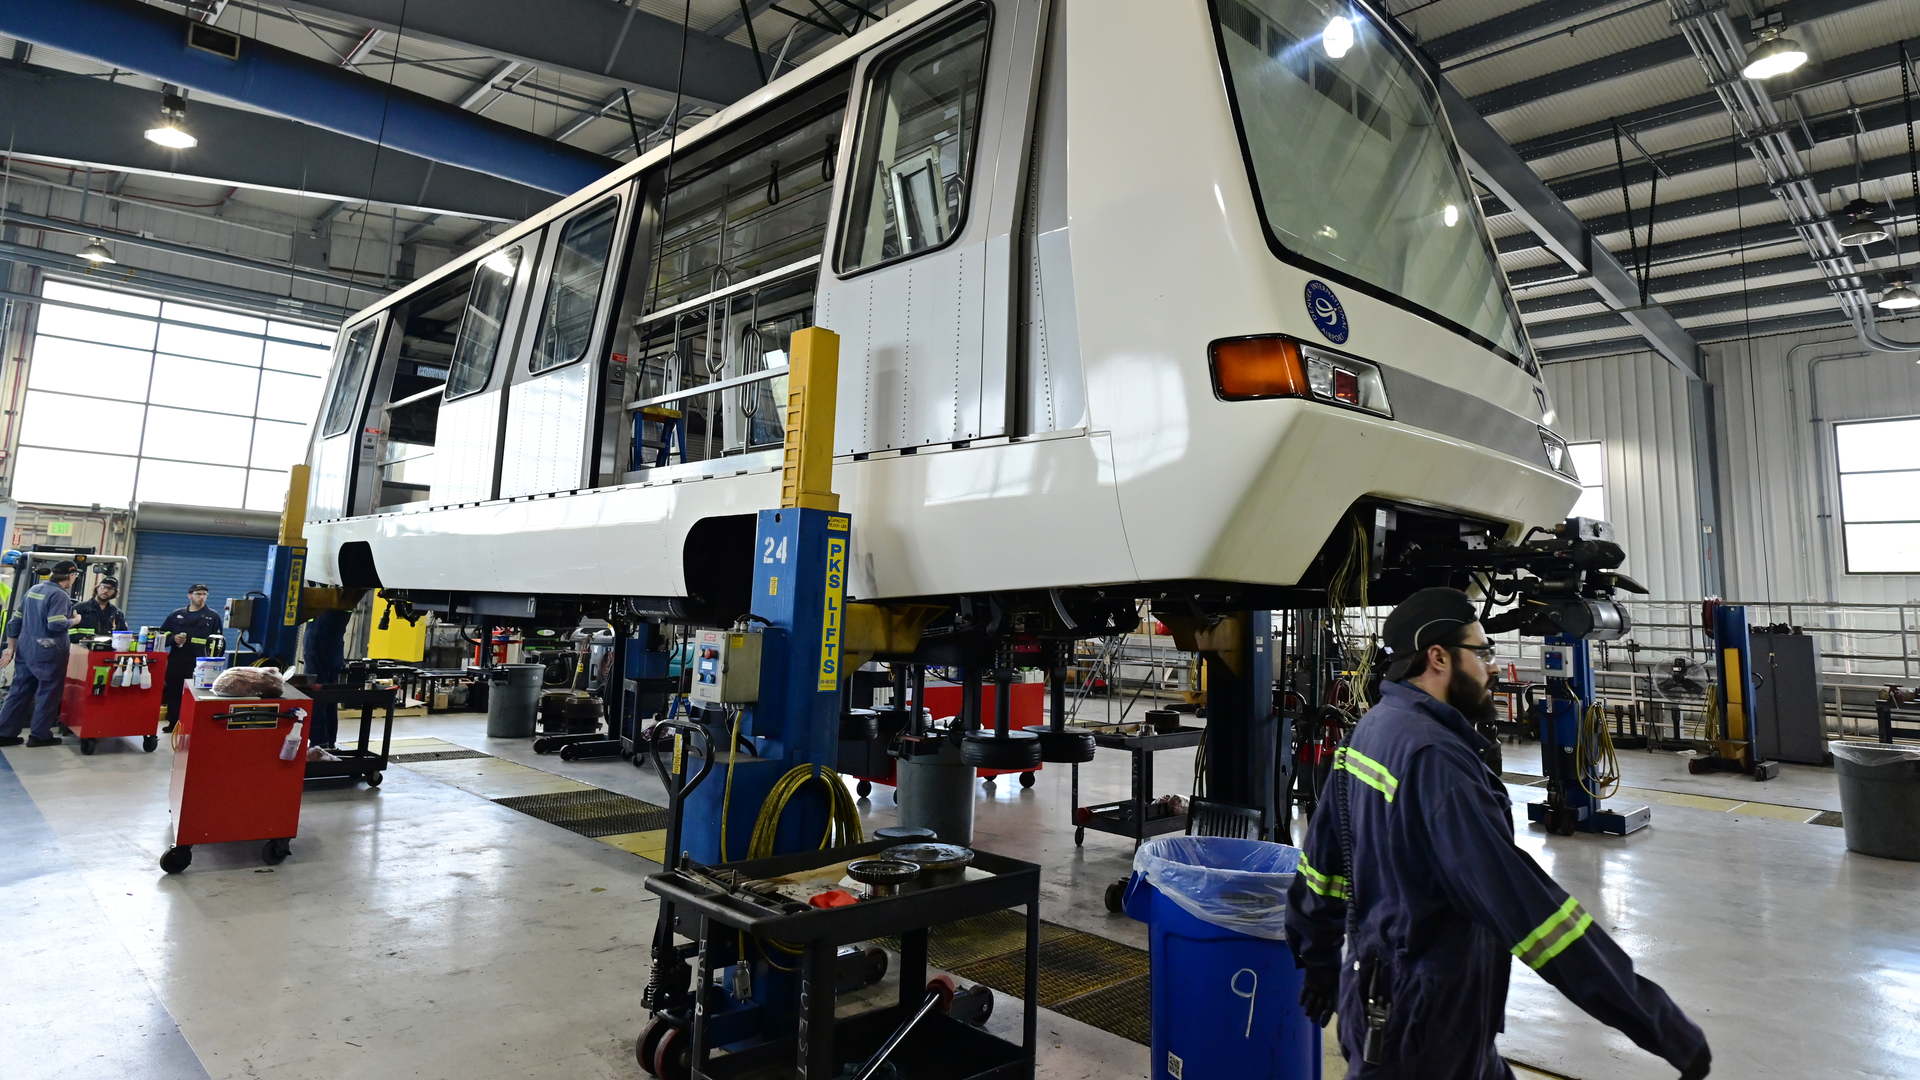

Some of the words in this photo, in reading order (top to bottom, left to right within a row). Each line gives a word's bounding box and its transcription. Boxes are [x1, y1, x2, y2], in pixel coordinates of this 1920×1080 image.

[1321, 327, 1345, 342] AIRPORT
[52, 522, 70, 534] EXIT
[763, 536, 788, 564] 24
[828, 543, 842, 589] PKS
[292, 561, 301, 582] PKS
[286, 585, 297, 619] LIFTS
[823, 597, 837, 675] LIFTS
[1231, 968, 1257, 1039] 9
[797, 979, 810, 1080] WEST
